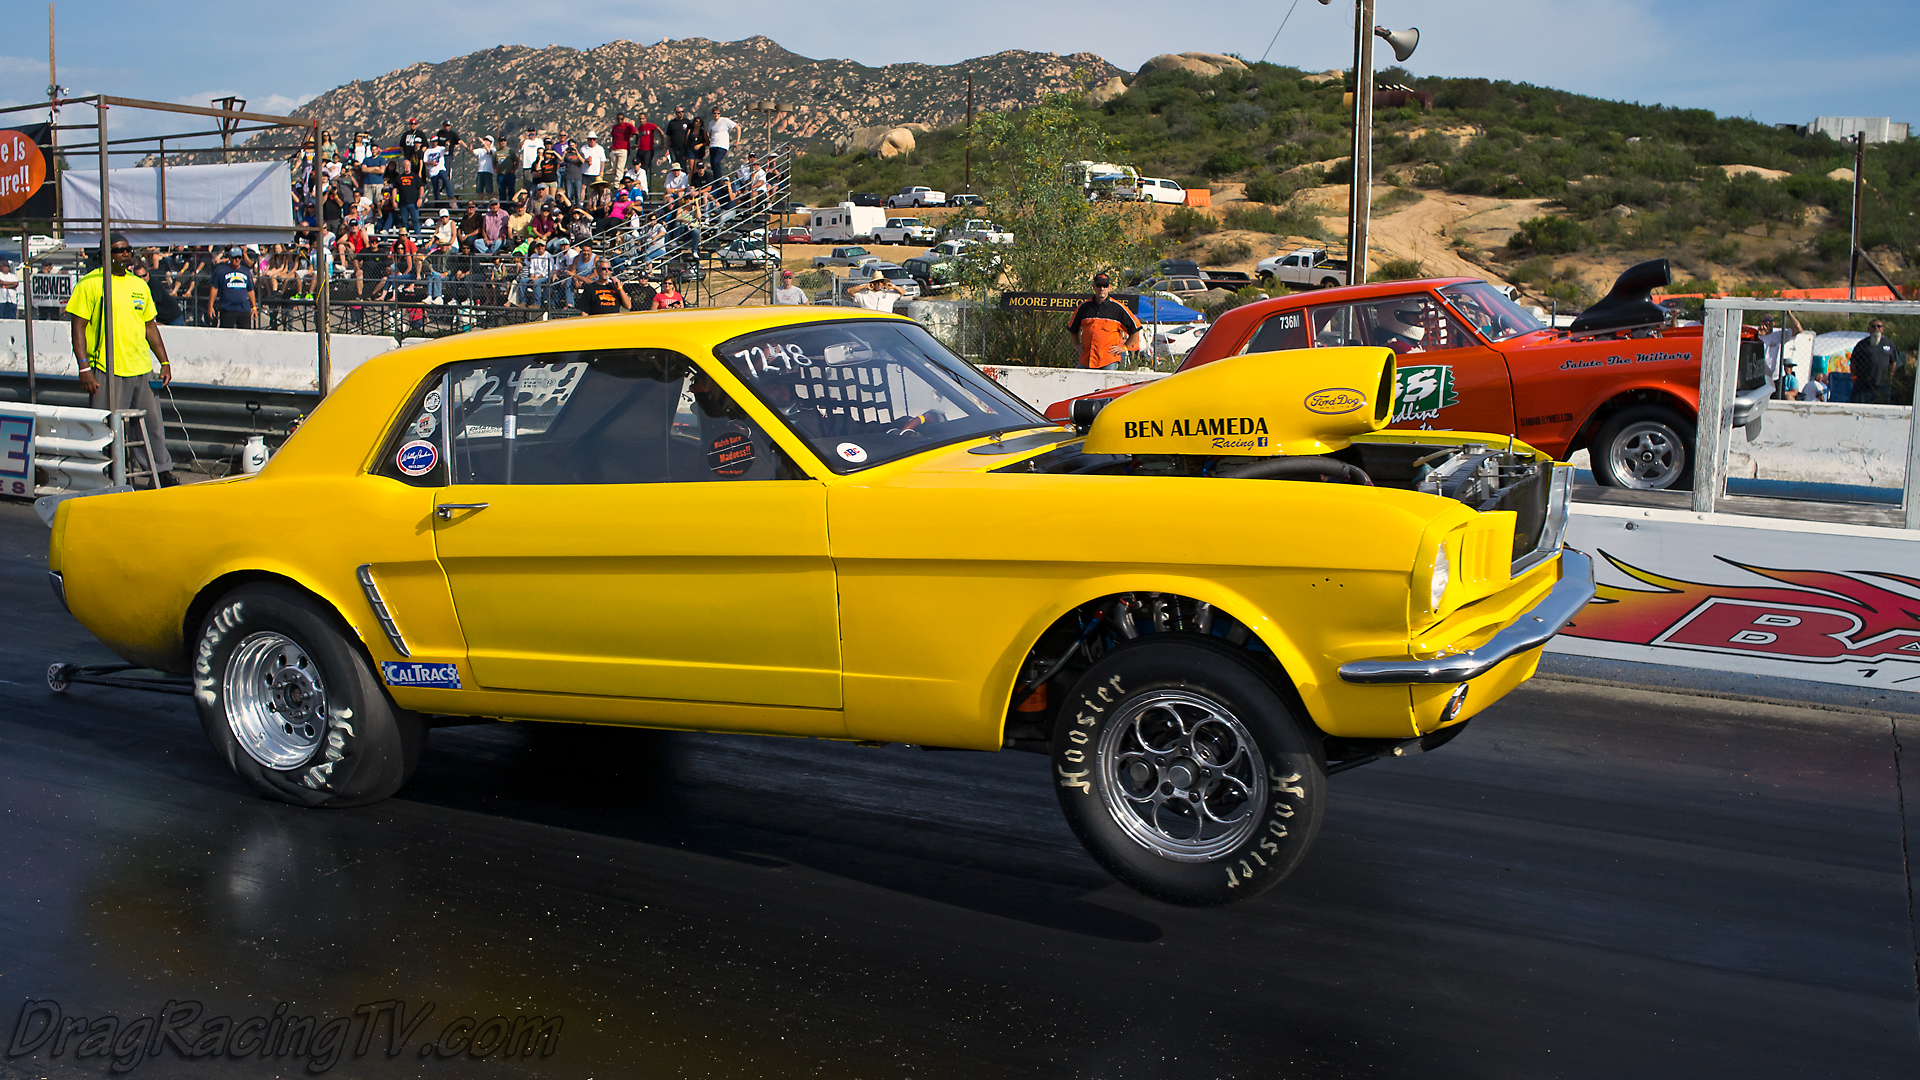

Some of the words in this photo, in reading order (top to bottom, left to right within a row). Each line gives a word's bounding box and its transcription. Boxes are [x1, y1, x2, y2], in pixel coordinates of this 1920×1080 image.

[13, 136, 26, 162] Is
[32, 275, 72, 296] CROWER
[1009, 296, 1048, 307] MOORE
[1279, 315, 1300, 330] 736M
[734, 343, 812, 379] 7248
[1560, 360, 1604, 370] Salute
[1607, 355, 1633, 366] The
[1635, 352, 1693, 363] Military
[1310, 394, 1336, 407] Ford
[1124, 420, 1163, 438] BEN
[1170, 417, 1269, 437] ALAMEDA
[714, 438, 729, 449] Match
[730, 436, 742, 445] Race
[1211, 437, 1255, 450] Racing
[719, 445, 751, 463] Madness!!
[843, 447, 861, 457] ABC
[1057, 674, 1126, 795] Hoosier
[1224, 765, 1306, 889] Hoosier
